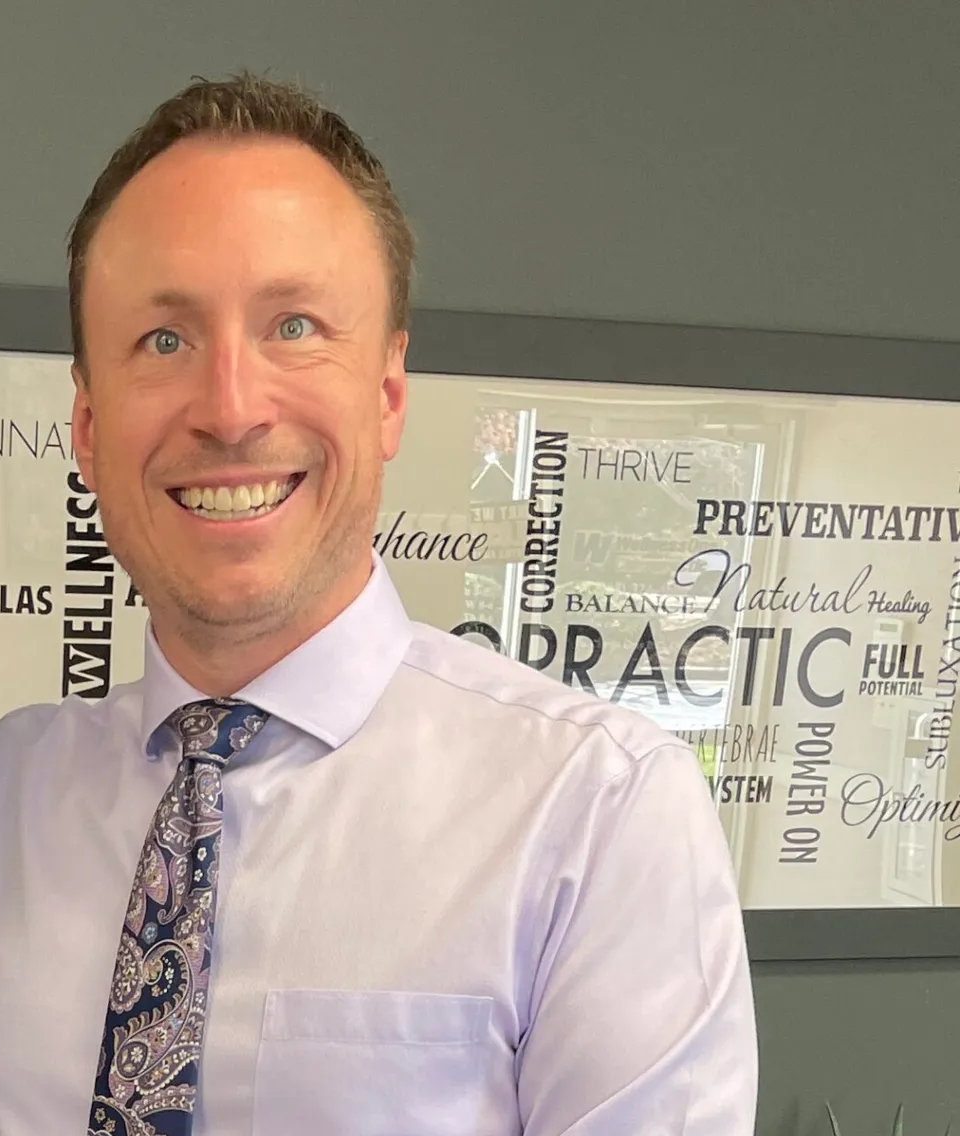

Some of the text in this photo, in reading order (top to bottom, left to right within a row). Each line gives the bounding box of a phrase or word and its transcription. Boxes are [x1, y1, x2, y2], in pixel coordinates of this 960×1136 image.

[578, 447, 694, 484] THRIVE
[520, 429, 569, 614] CORRECTION
[565, 593, 697, 614] BALANCE
[674, 548, 873, 615] Natural
[867, 589, 932, 624] Healing
[861, 643, 925, 679] FULL
[858, 681, 924, 697] POTENTIAL
[704, 774, 774, 804] YSTEM
[778, 722, 836, 864] POWER ON
